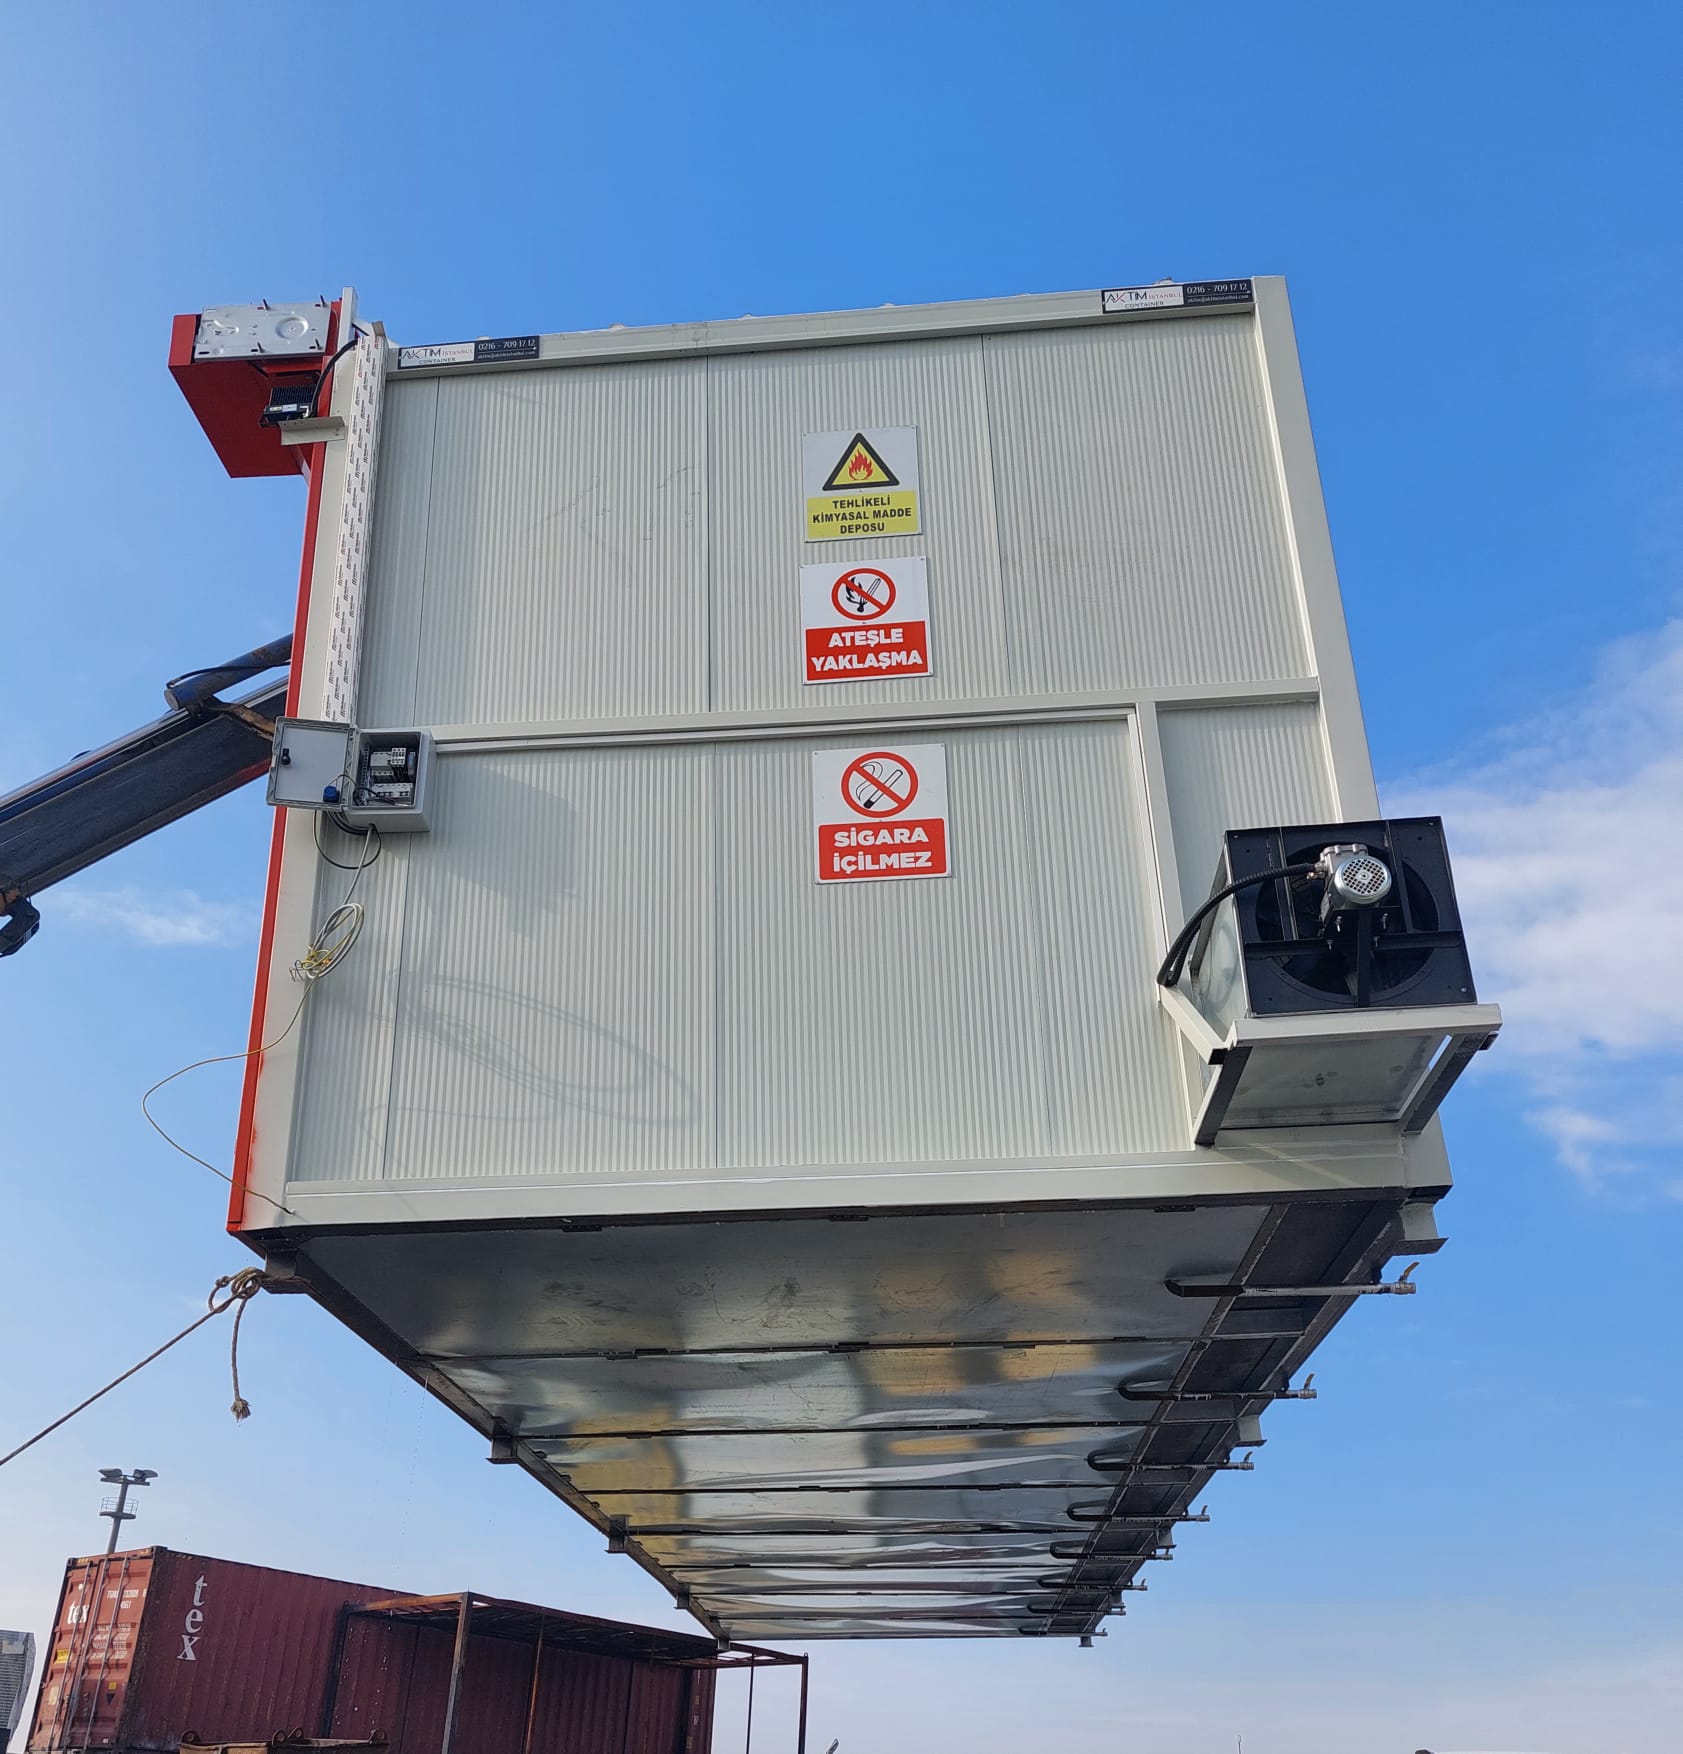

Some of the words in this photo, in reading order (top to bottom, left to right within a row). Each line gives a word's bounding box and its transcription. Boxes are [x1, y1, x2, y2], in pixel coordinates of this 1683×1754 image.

[1186, 286, 1206, 295] 0216
[1213, 283, 1228, 292] 709
[1229, 283, 1237, 292] 17
[1239, 282, 1248, 291] 12
[478, 342, 496, 351] 0216
[503, 340, 517, 349] 709
[519, 339, 527, 348] 17
[528, 339, 536, 347] 12
[833, 494, 891, 509] TEHLİKELİ
[812, 510, 870, 523] KİMYASAL
[872, 507, 912, 520] MADDE
[840, 522, 885, 534] DEPOSU
[829, 628, 904, 648] ATEŞLE
[811, 649, 923, 672] YAKLAŞMA
[834, 827, 929, 848] SİGARA
[833, 851, 932, 874] İÇİLMEZ
[177, 1575, 208, 1661] tex
